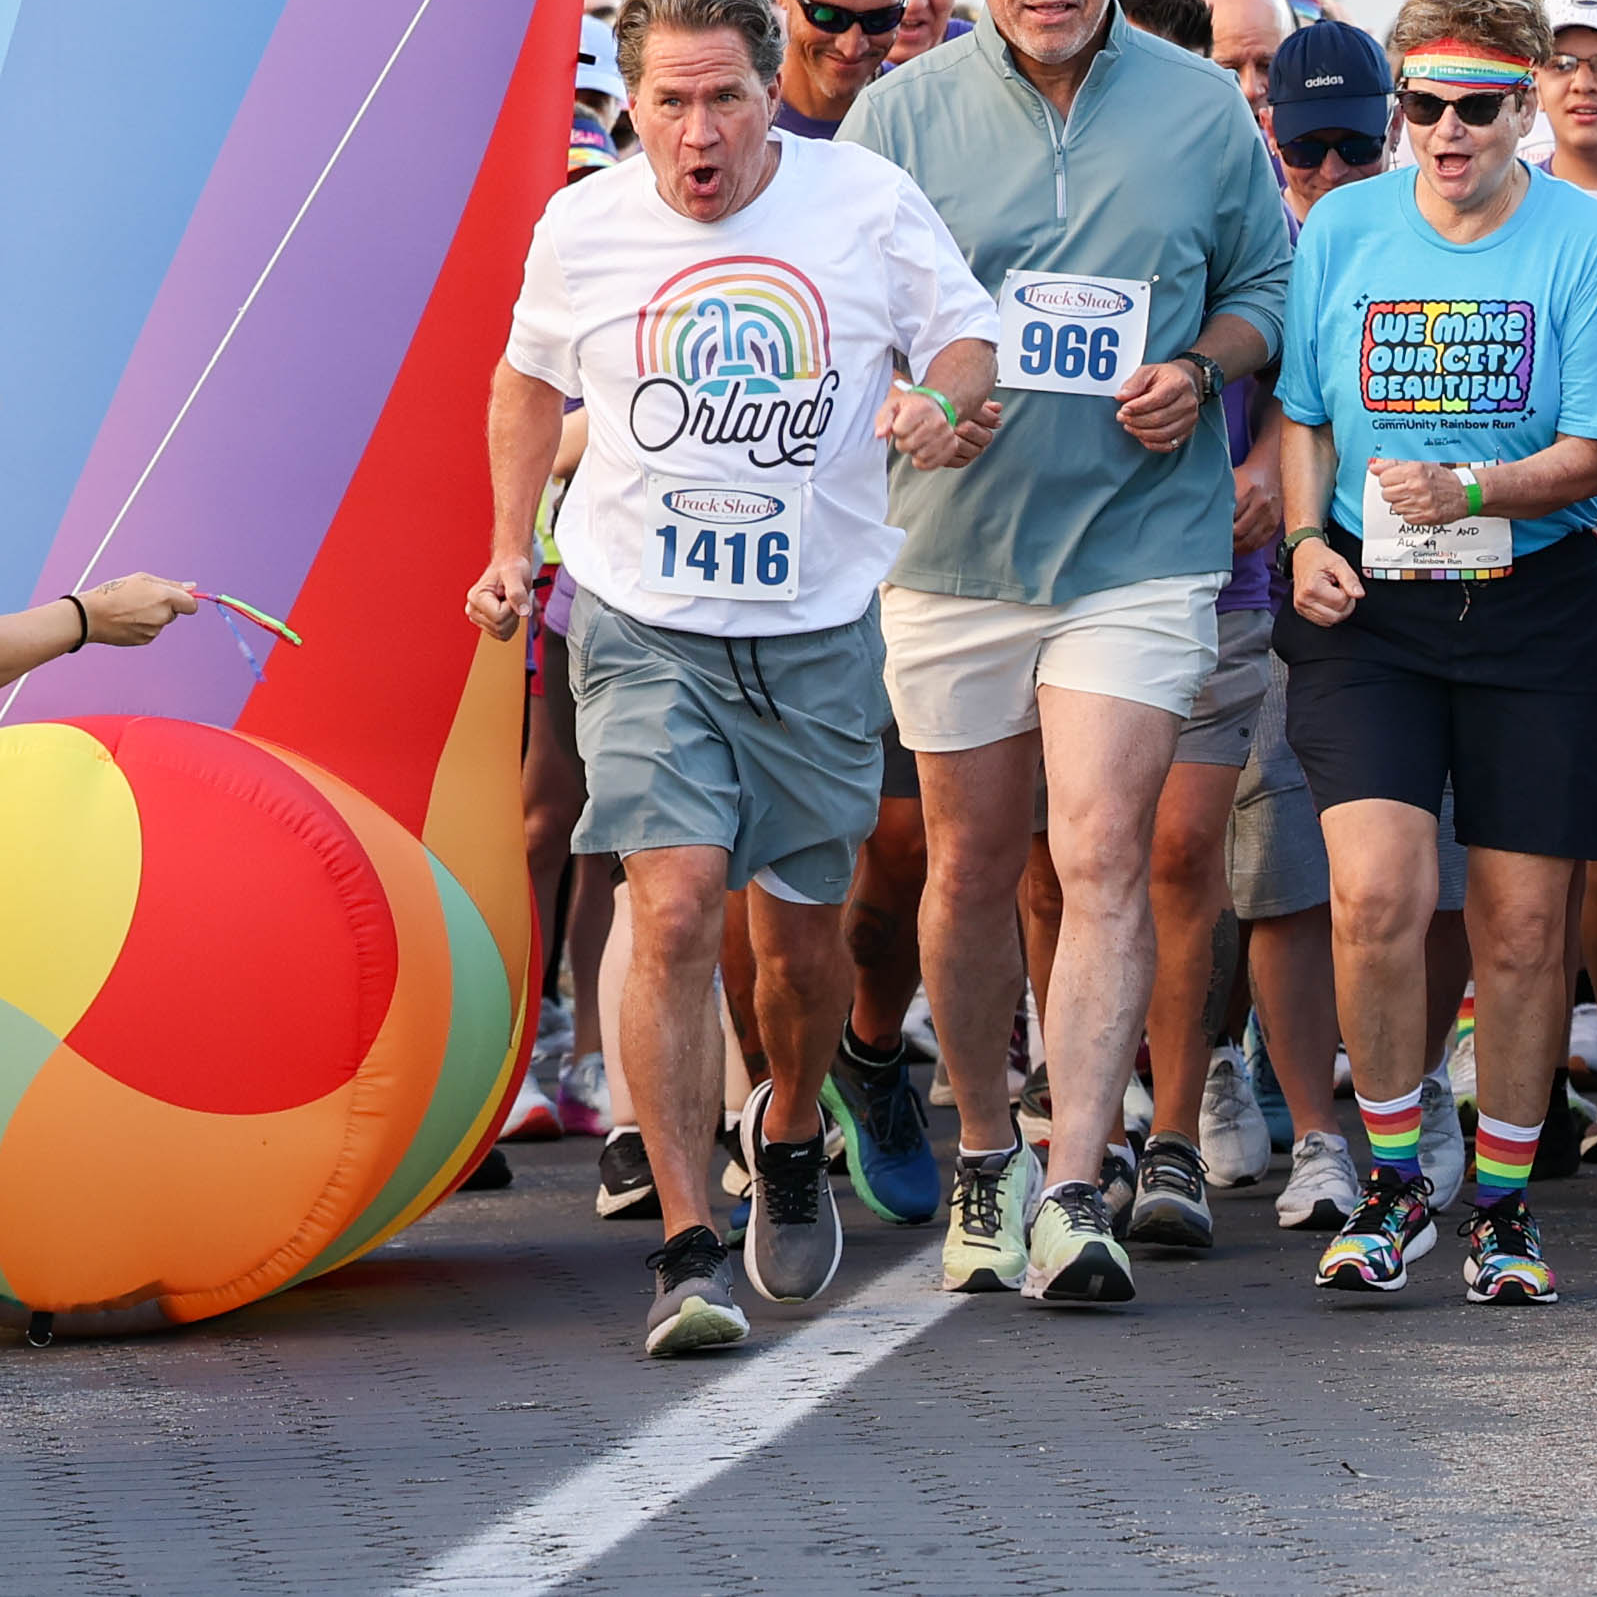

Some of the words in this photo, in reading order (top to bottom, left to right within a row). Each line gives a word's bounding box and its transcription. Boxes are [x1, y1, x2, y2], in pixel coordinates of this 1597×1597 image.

[1304, 75, 1344, 88] adidas
[1025, 286, 1074, 307] Track
[1075, 292, 1127, 312] Shack
[1371, 313, 1427, 344] WE
[1432, 312, 1527, 344] MAKE
[1020, 321, 1120, 381] 966
[1368, 345, 1437, 374] OUR
[1442, 344, 1525, 374] CITY
[1367, 374, 1524, 402] BEAUTIFUL
[630, 370, 839, 468] Orlando
[1372, 418, 1437, 431] CommUnity
[1440, 418, 1489, 430] Rainbow
[1492, 418, 1516, 430] Run
[673, 492, 720, 513] Track
[721, 497, 778, 514] Shack
[1397, 538, 1417, 548] ALL
[1423, 540, 1437, 550] 49
[1456, 527, 1480, 536] AND
[656, 525, 790, 586] 1416
